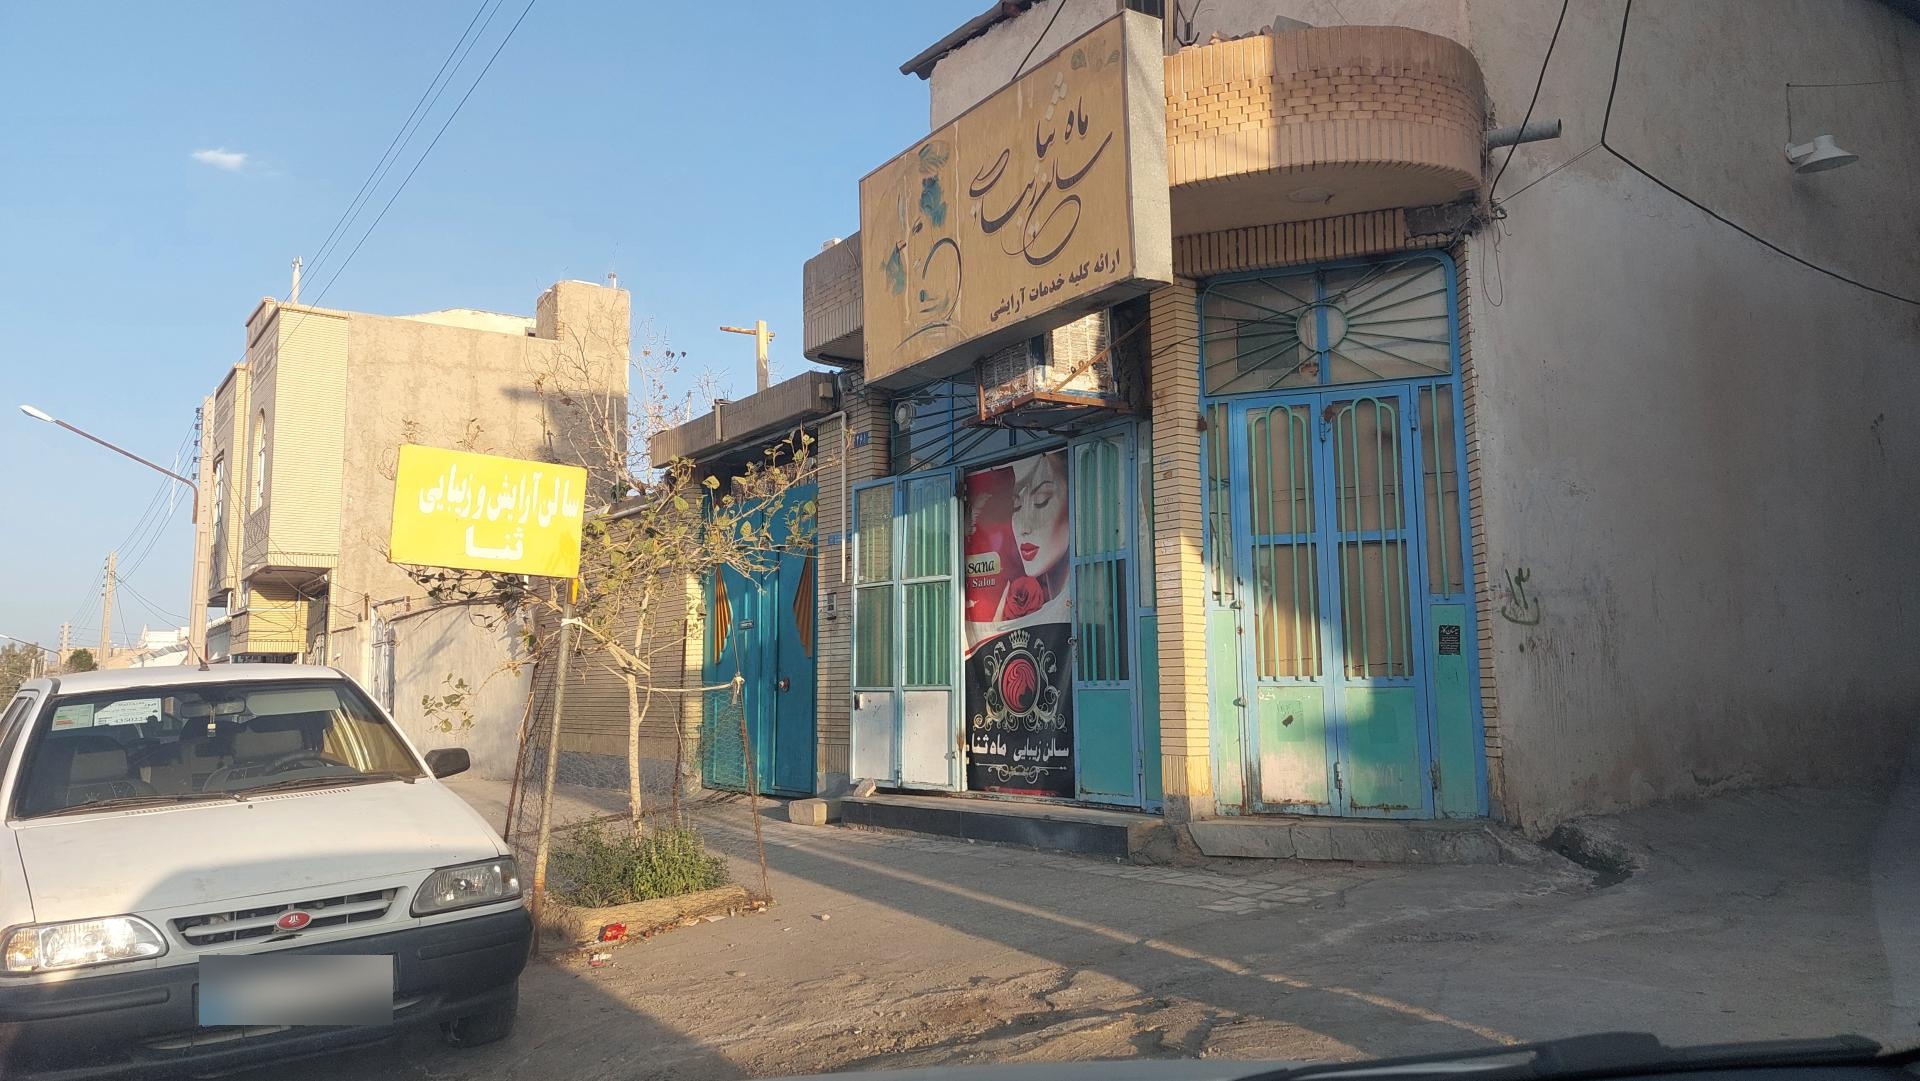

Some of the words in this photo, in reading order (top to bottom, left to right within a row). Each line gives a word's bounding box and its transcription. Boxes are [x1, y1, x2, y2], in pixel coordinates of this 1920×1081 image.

[1064, 96, 1089, 141] ماه
[1001, 131, 1113, 266] سالن
[1068, 261, 1090, 287] کلیه
[1094, 248, 1120, 274] ارائه
[1029, 273, 1065, 302] خدمات
[990, 286, 1026, 322] آرایشی
[418, 463, 475, 519] زیبایی
[473, 484, 486, 520] و
[486, 471, 543, 525] آرایش
[464, 525, 525, 561] ثنا
[972, 577, 996, 588] Salon
[971, 732, 989, 754] ثنا
[989, 733, 1007, 757] ماه
[1013, 737, 1042, 762] زیبایی
[1042, 737, 1069, 762] سالن
